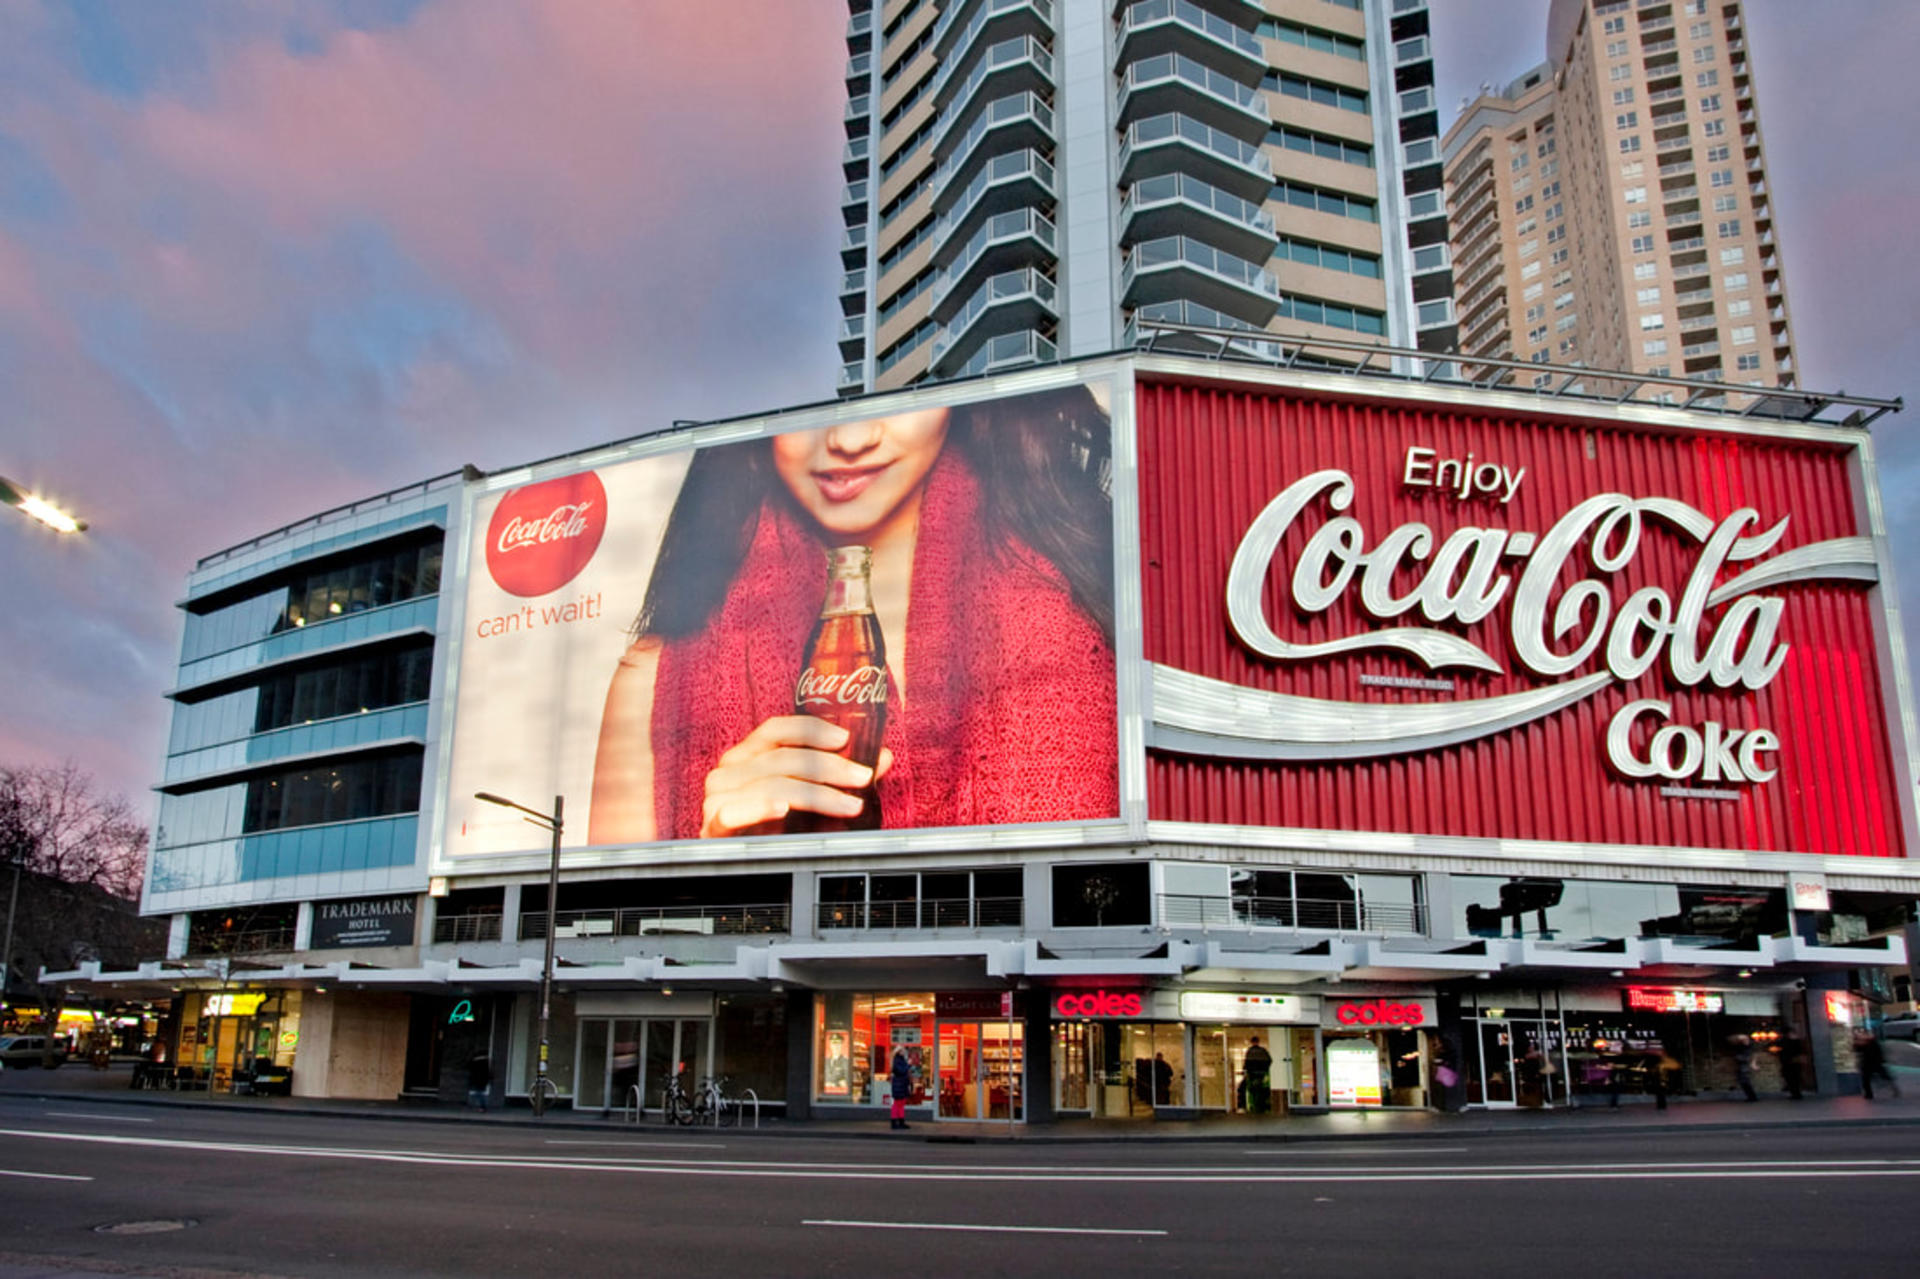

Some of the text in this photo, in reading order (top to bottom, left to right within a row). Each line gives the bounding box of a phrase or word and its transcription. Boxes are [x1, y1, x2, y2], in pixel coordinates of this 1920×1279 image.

[1404, 446, 1526, 503] Enjoy
[498, 500, 594, 553] Coca-Cola
[1226, 469, 1791, 690] Coca-Cola
[477, 592, 602, 639] can't wait!
[1361, 674, 1393, 686] TRADE
[1395, 677, 1423, 688] MARK
[1607, 699, 1780, 783] Coke
[321, 898, 414, 919] TRADEMARK
[348, 919, 380, 930] HOTEL
[1057, 990, 1143, 1016] coles
[1337, 998, 1424, 1025] coles
